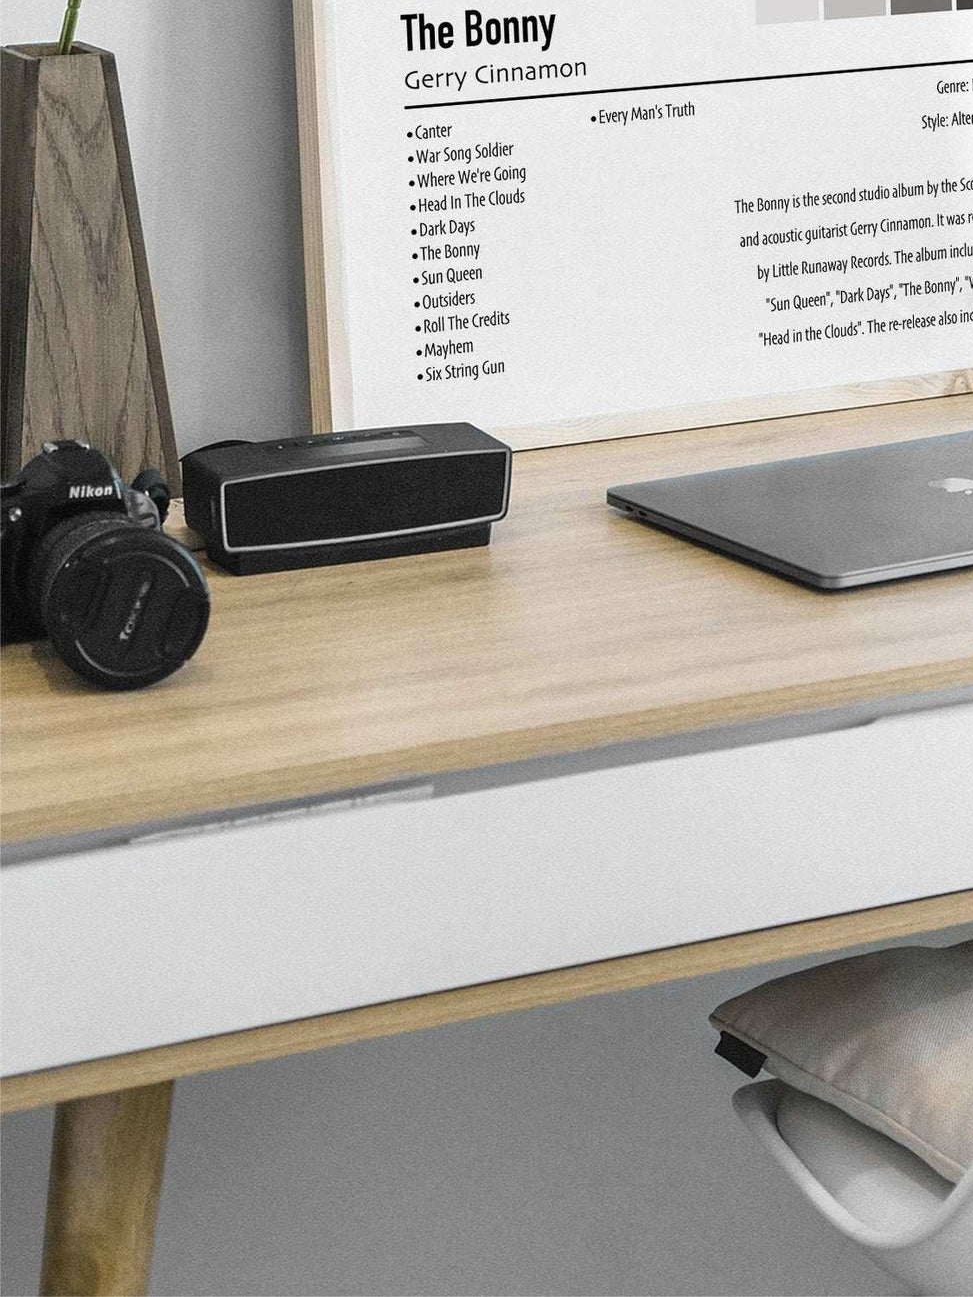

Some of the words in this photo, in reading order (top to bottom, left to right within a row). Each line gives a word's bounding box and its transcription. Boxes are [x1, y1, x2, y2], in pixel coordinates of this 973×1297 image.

[400, 13, 454, 51] The
[465, 10, 556, 50] Bonny
[405, 71, 467, 91] Gerry
[475, 61, 586, 84] Cinnamon
[937, 80, 969, 94] Genre:
[599, 110, 628, 126] Every
[631, 104, 663, 121] Man's
[665, 101, 695, 118] Truth
[922, 113, 948, 132] Style:
[415, 125, 452, 139] Canter
[416, 149, 441, 164] War
[444, 147, 471, 164] Song
[475, 142, 514, 159] Soldier
[417, 172, 455, 188] Where
[458, 168, 491, 184] We're
[494, 166, 526, 183] Going
[419, 195, 447, 212] Head
[451, 196, 461, 209] In
[464, 192, 485, 208] The
[489, 188, 525, 206] Clouds
[734, 199, 754, 214] The
[757, 198, 790, 213] Bonny
[793, 194, 800, 208] is
[803, 192, 820, 207] the
[822, 188, 856, 205] second
[859, 185, 890, 201] studio
[892, 183, 924, 198] album
[927, 180, 939, 198] by
[941, 178, 957, 193] the
[420, 220, 446, 237] Dark
[449, 220, 475, 237] Days
[740, 231, 759, 247] and
[762, 228, 803, 245] acoustic
[805, 224, 848, 245] guitarist
[850, 222, 878, 237] Gerry
[880, 217, 934, 232] Cinnamon.
[937, 214, 944, 227] It
[946, 214, 965, 225] was
[420, 245, 441, 261] The
[445, 244, 480, 260] Bonny
[757, 265, 769, 282] by
[773, 261, 798, 277] Little
[802, 260, 848, 274] Runaway
[851, 252, 891, 269] Records.
[894, 249, 913, 264] The
[916, 247, 947, 262] album
[422, 271, 443, 285] Sun
[446, 268, 482, 283] Queen
[423, 291, 475, 309] Outsiders
[766, 298, 790, 312] "Sun
[793, 291, 833, 310] Queen",
[836, 288, 864, 303] "Dark
[867, 284, 897, 303] Days",
[899, 282, 922, 296] "The
[925, 277, 962, 295] Bonny",
[424, 316, 445, 334] Roll
[447, 315, 469, 330] The
[472, 311, 510, 328] Credits
[759, 329, 789, 346] "Head
[793, 329, 802, 343] in
[805, 326, 822, 341] the
[825, 321, 864, 339] Clouds".
[867, 319, 886, 334] The
[889, 314, 936, 331] re-release
[939, 311, 957, 325] also
[425, 340, 473, 359] Mayhem
[426, 367, 442, 382] Six
[445, 363, 478, 380] String
[482, 360, 504, 375] Gun
[69, 485, 113, 499] Nikon
